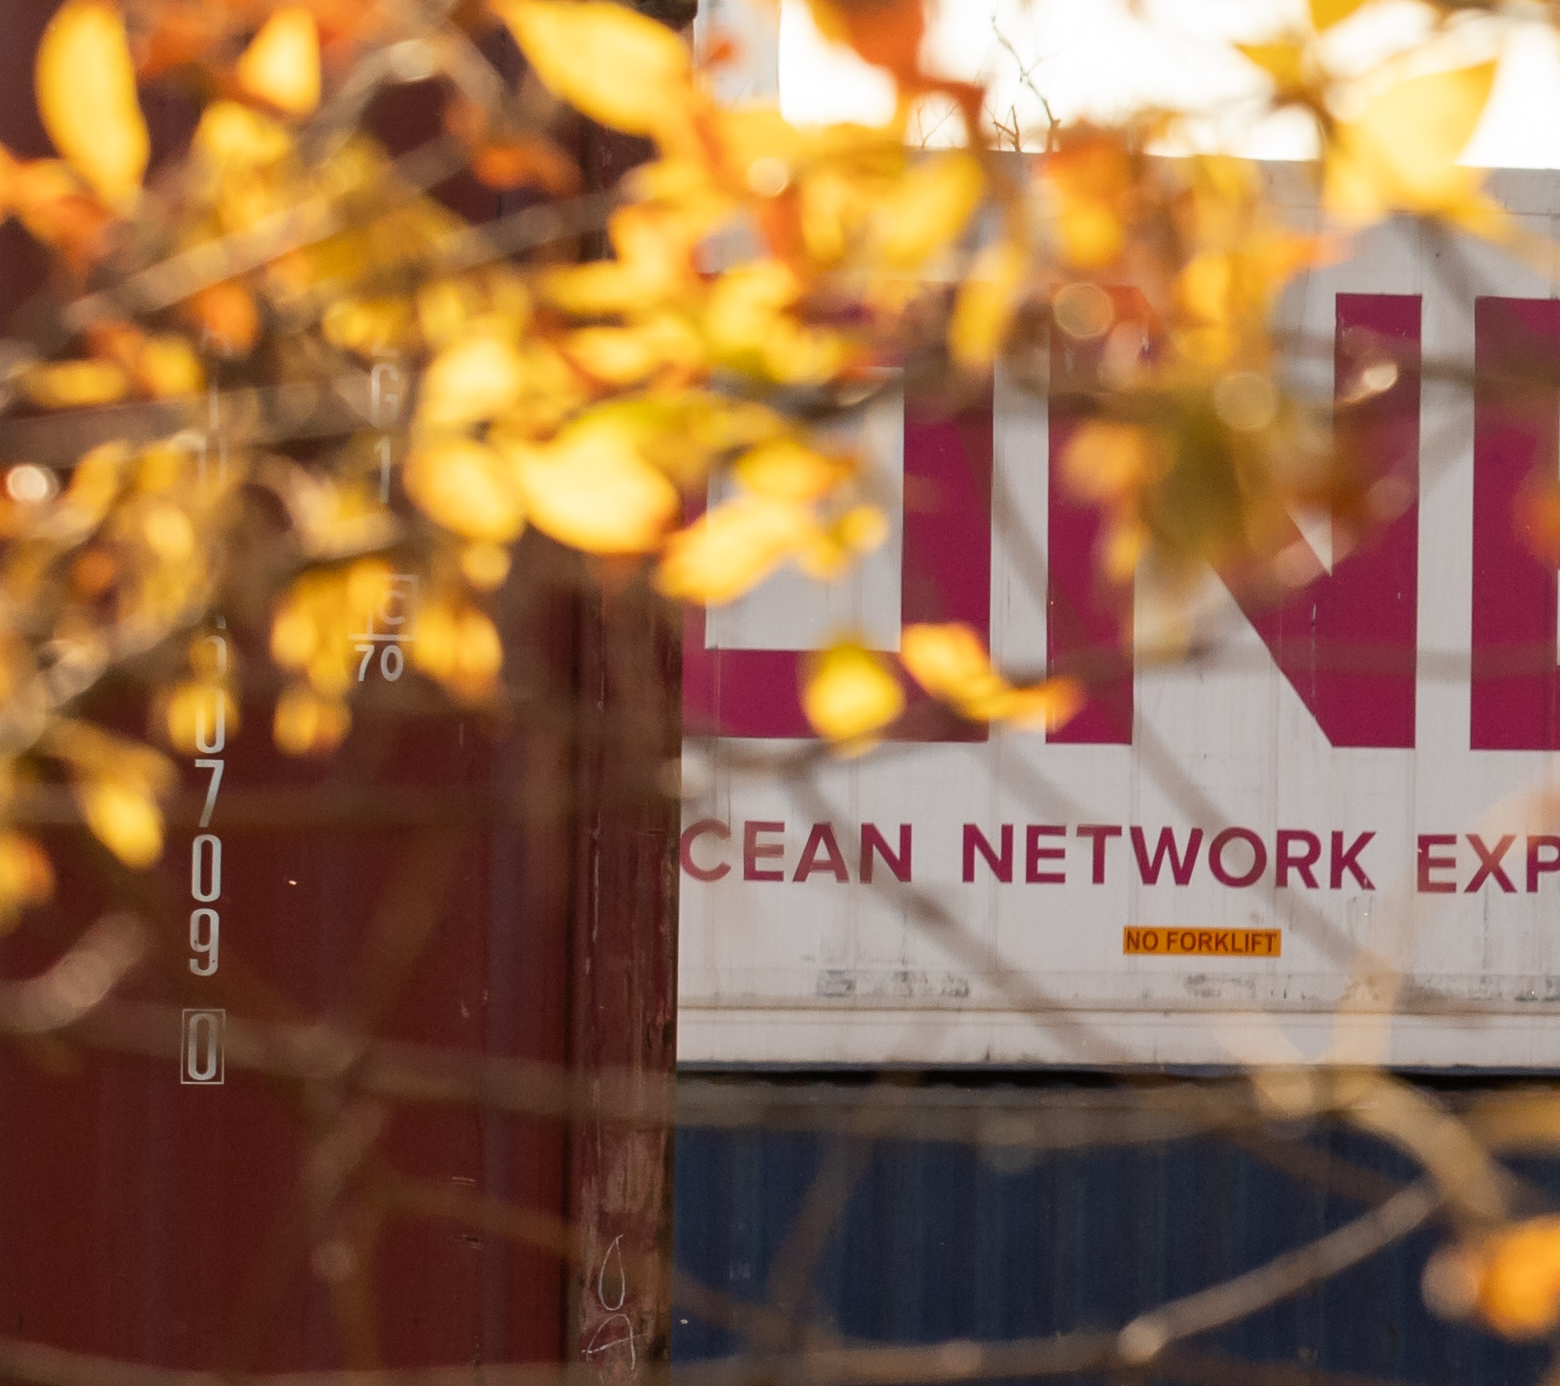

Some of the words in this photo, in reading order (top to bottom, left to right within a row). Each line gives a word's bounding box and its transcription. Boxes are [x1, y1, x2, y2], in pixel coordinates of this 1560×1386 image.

[354, 645, 405, 683] 70
[679, 819, 914, 886] CEAN
[962, 821, 1378, 894] NETWORK
[1125, 929, 1158, 955] NO
[1165, 929, 1278, 957] FORKLIFT
